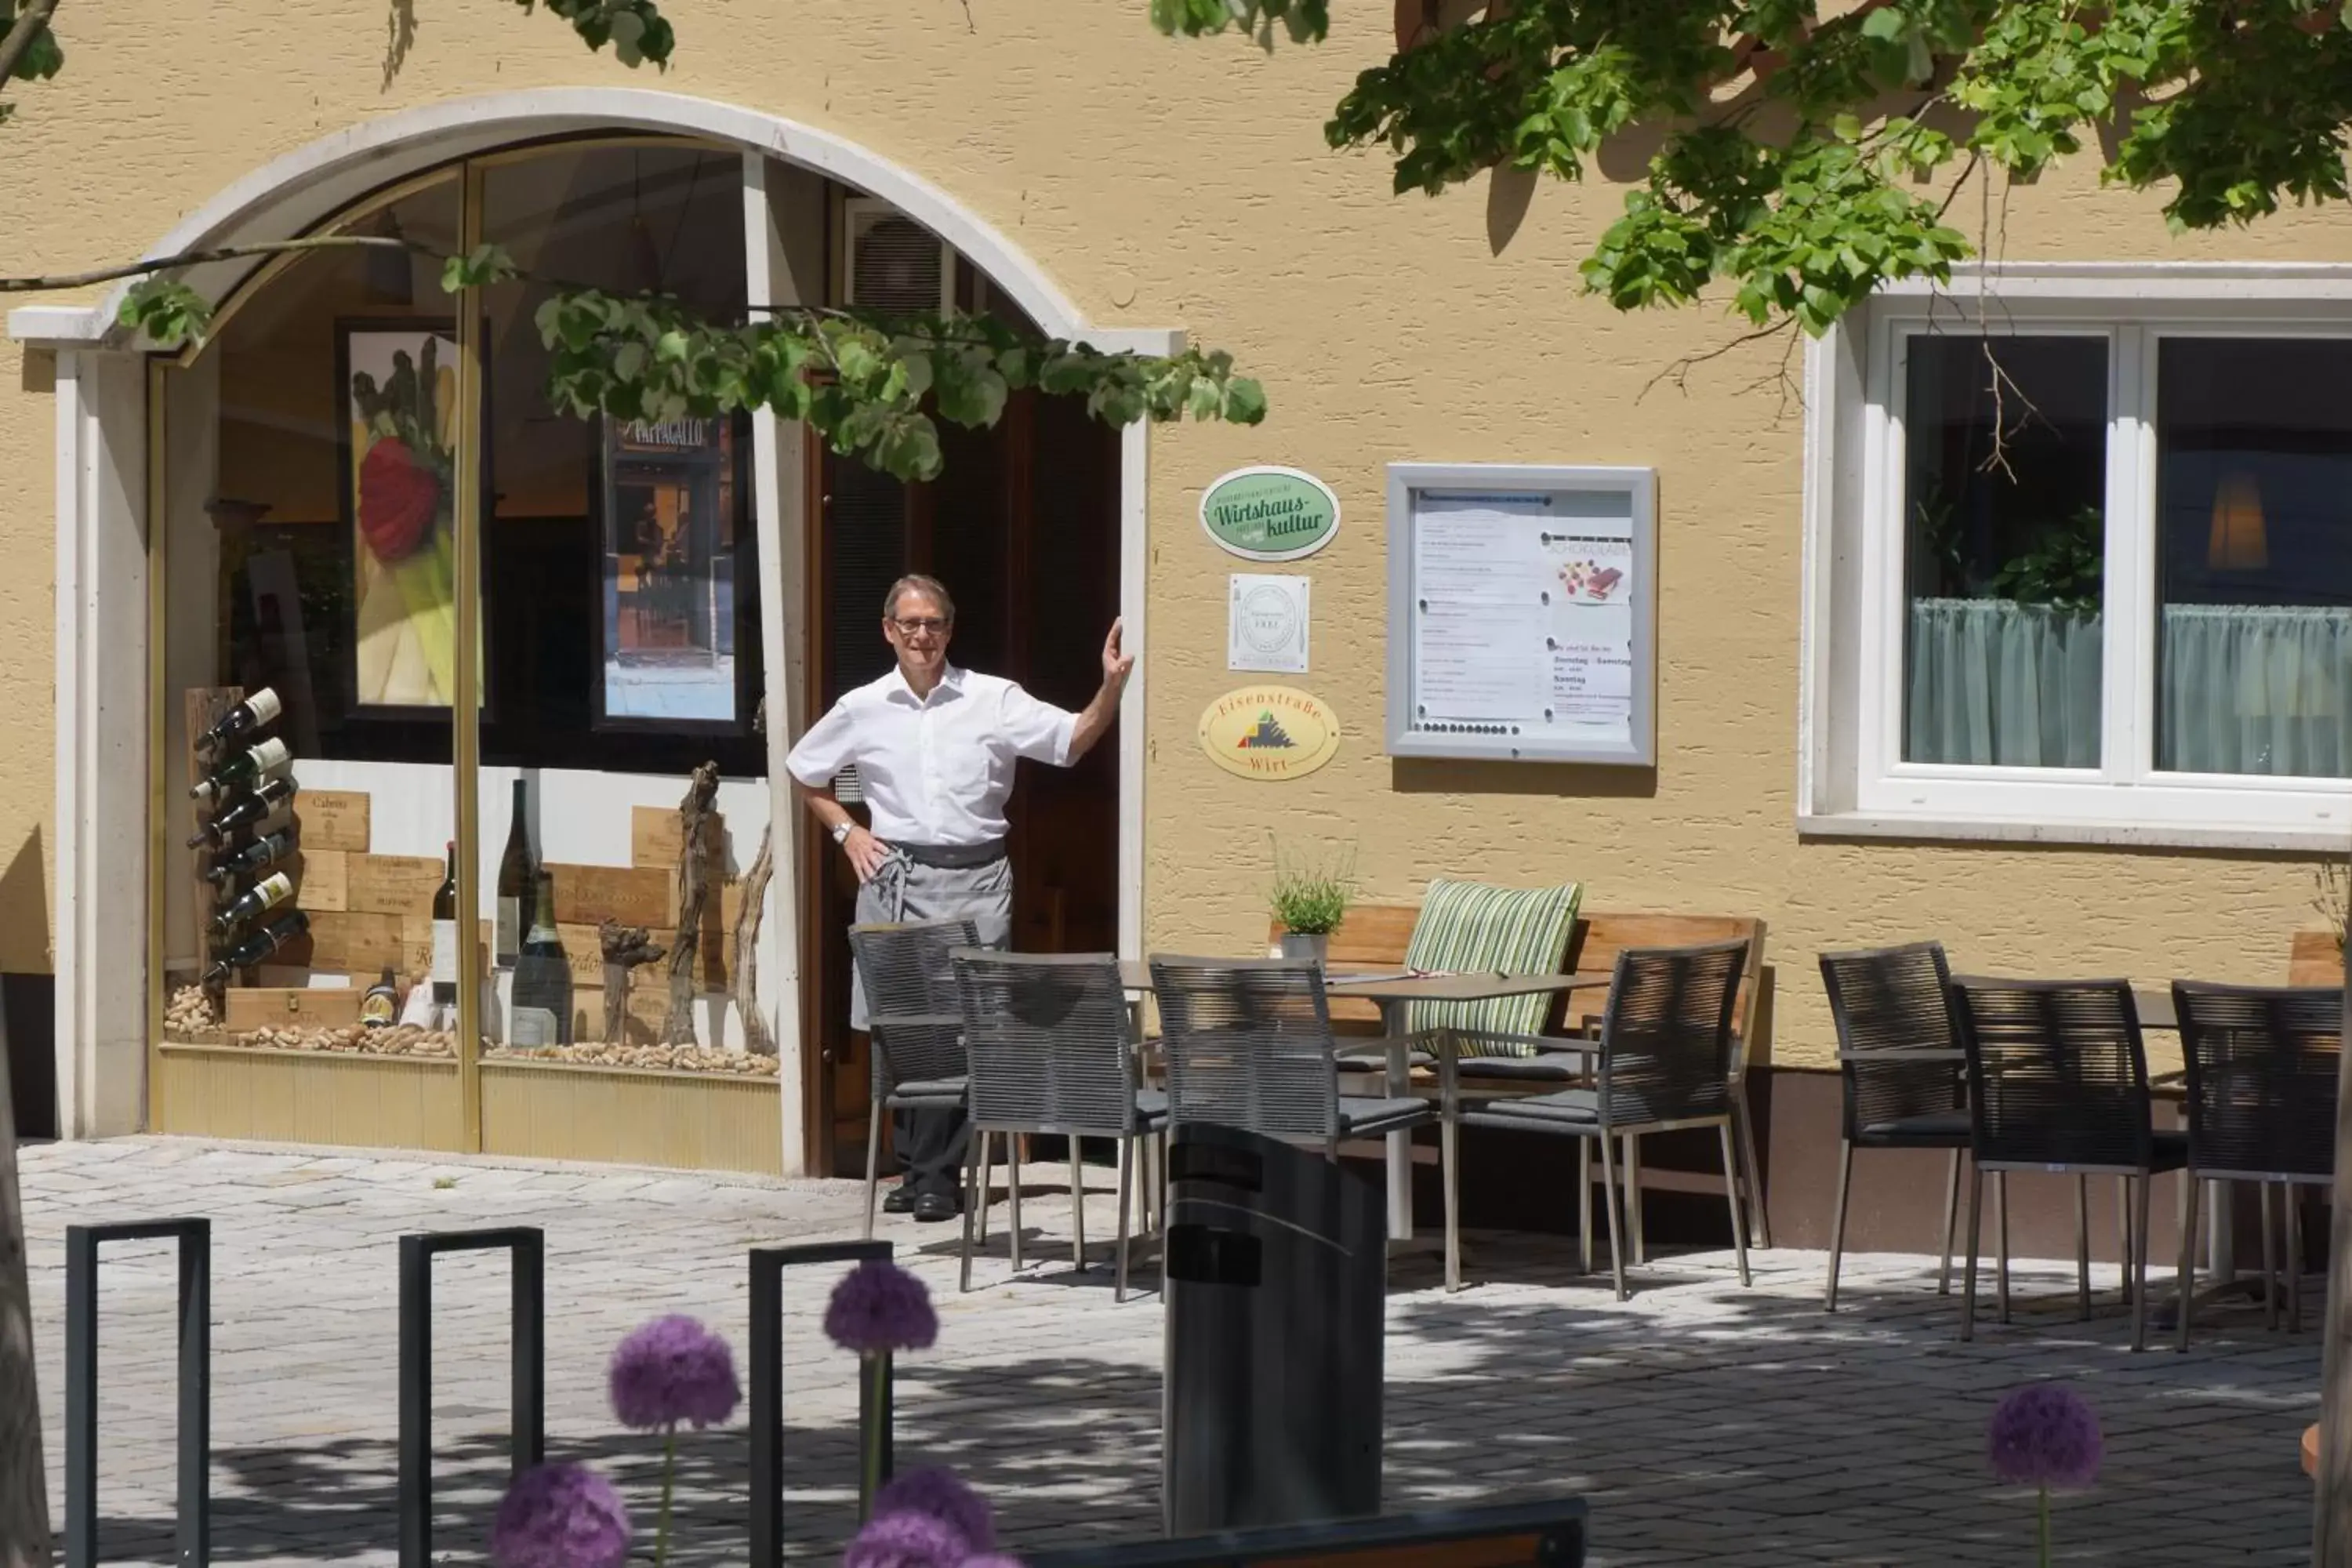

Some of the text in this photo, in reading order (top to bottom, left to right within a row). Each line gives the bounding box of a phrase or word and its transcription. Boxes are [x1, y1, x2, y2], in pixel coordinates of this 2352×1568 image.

[1214, 496, 1309, 526] Wirtshaus-
[1266, 514, 1323, 538] kultur
[1249, 757, 1287, 772] Wirt
